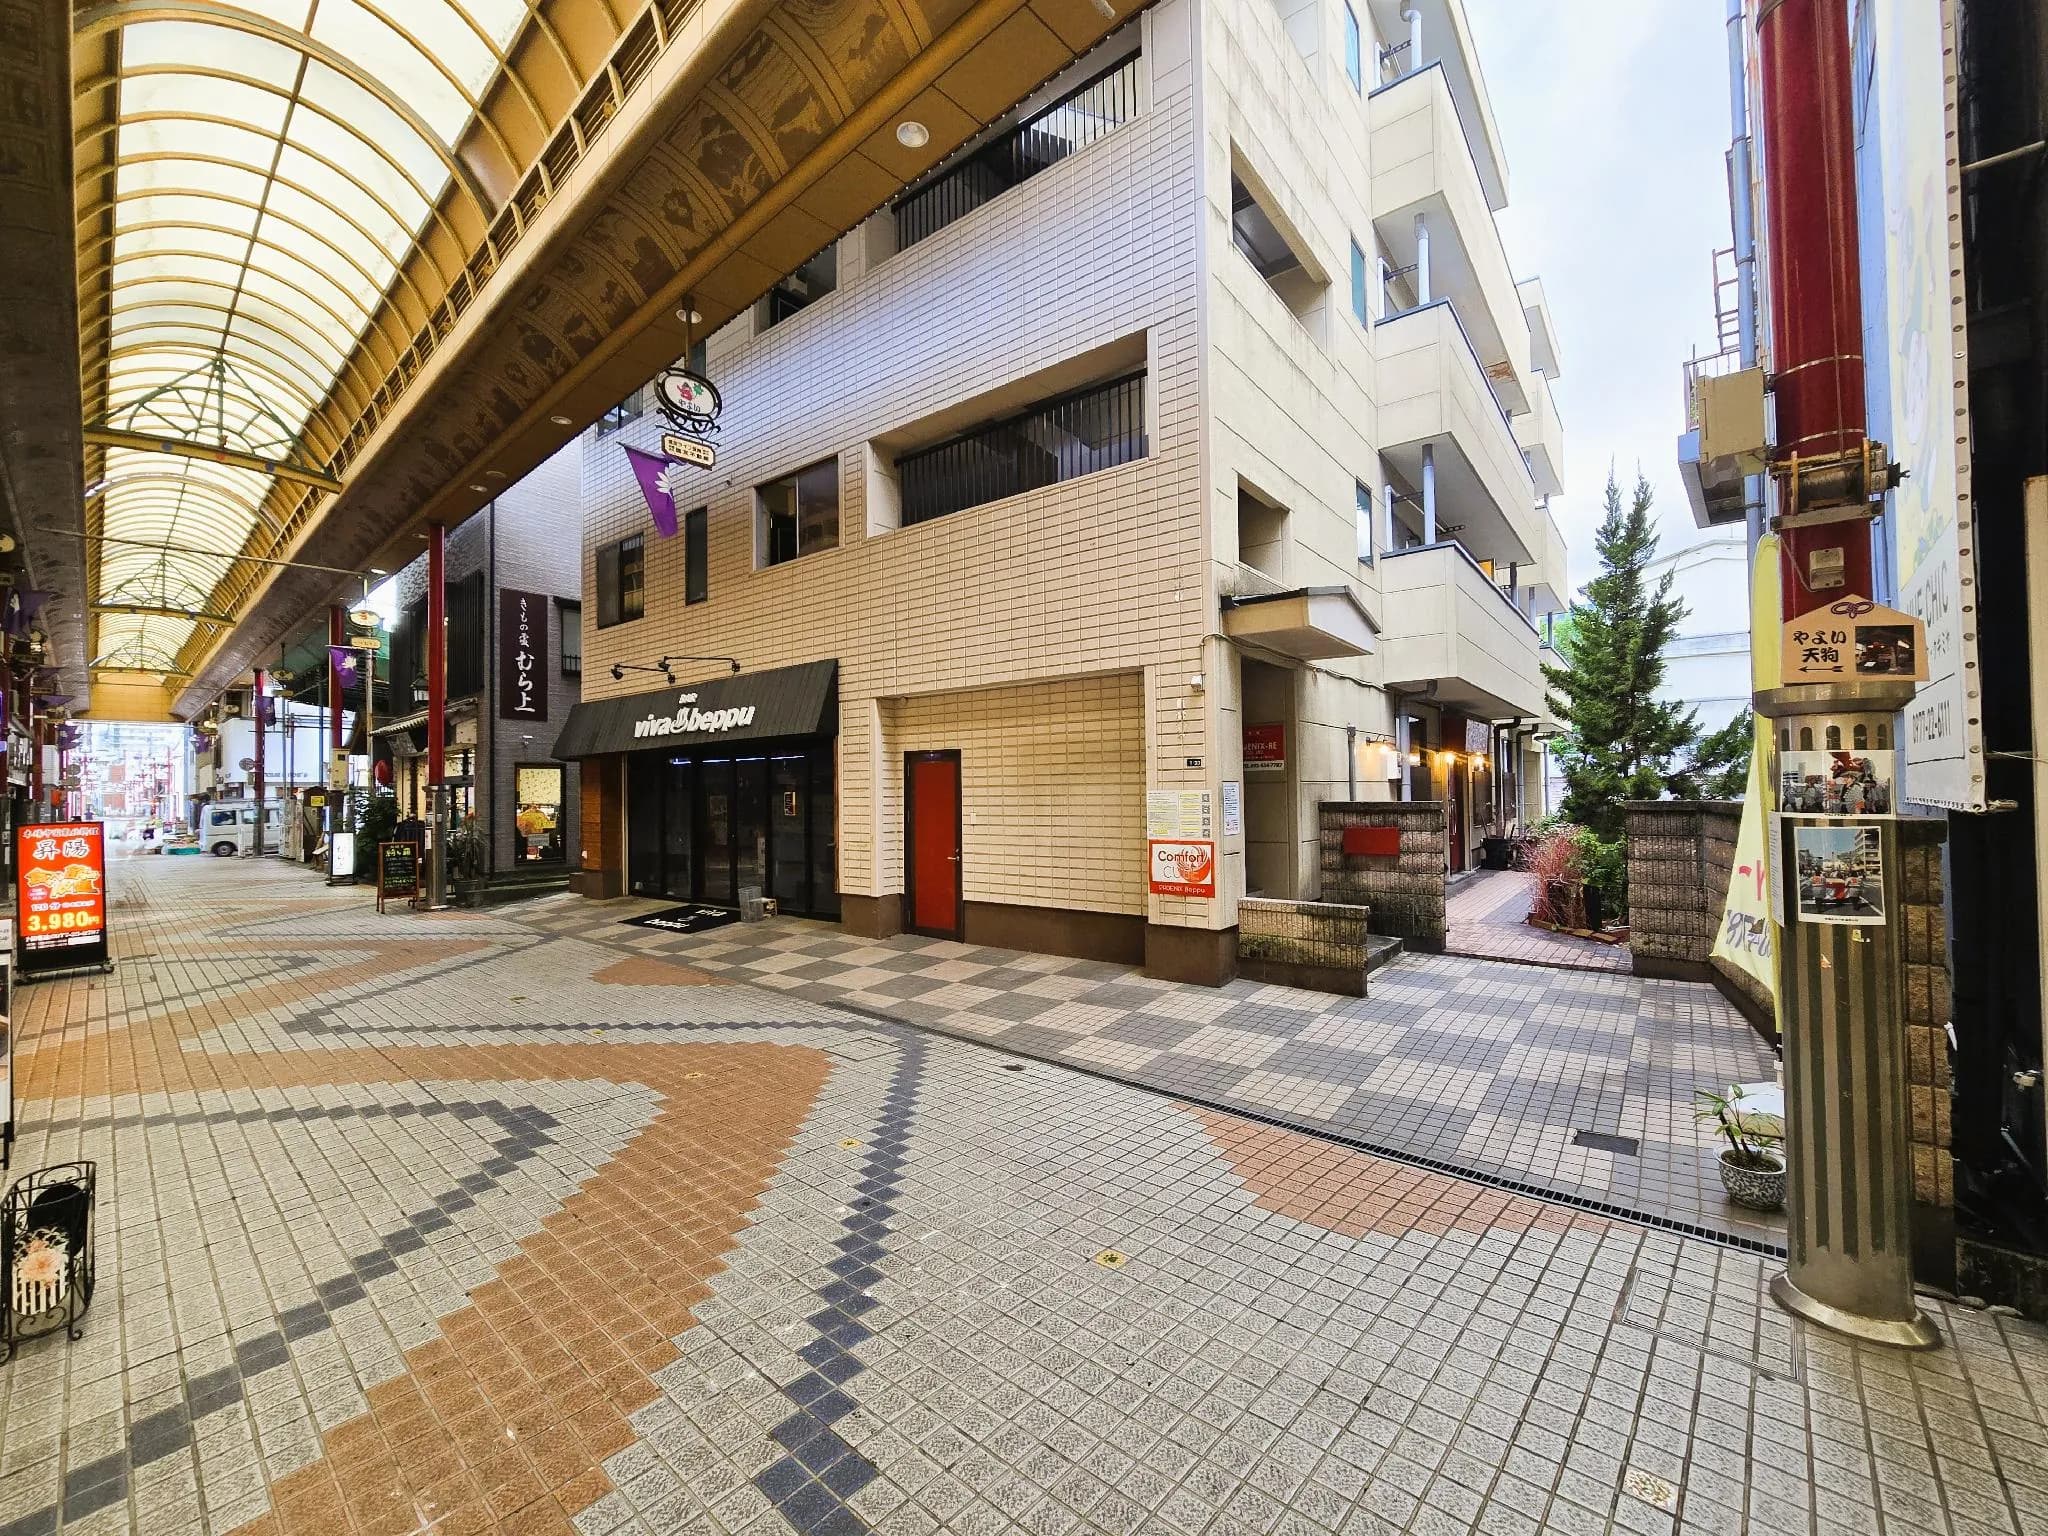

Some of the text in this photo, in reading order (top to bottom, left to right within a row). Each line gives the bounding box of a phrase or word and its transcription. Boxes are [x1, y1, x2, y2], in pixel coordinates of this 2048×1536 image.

[1793, 630, 1847, 645] やよい
[1802, 647, 1839, 663] 天狗
[514, 650, 536, 712] むら上
[634, 705, 756, 738] viva beppu
[1158, 850, 1206, 863] Comfort
